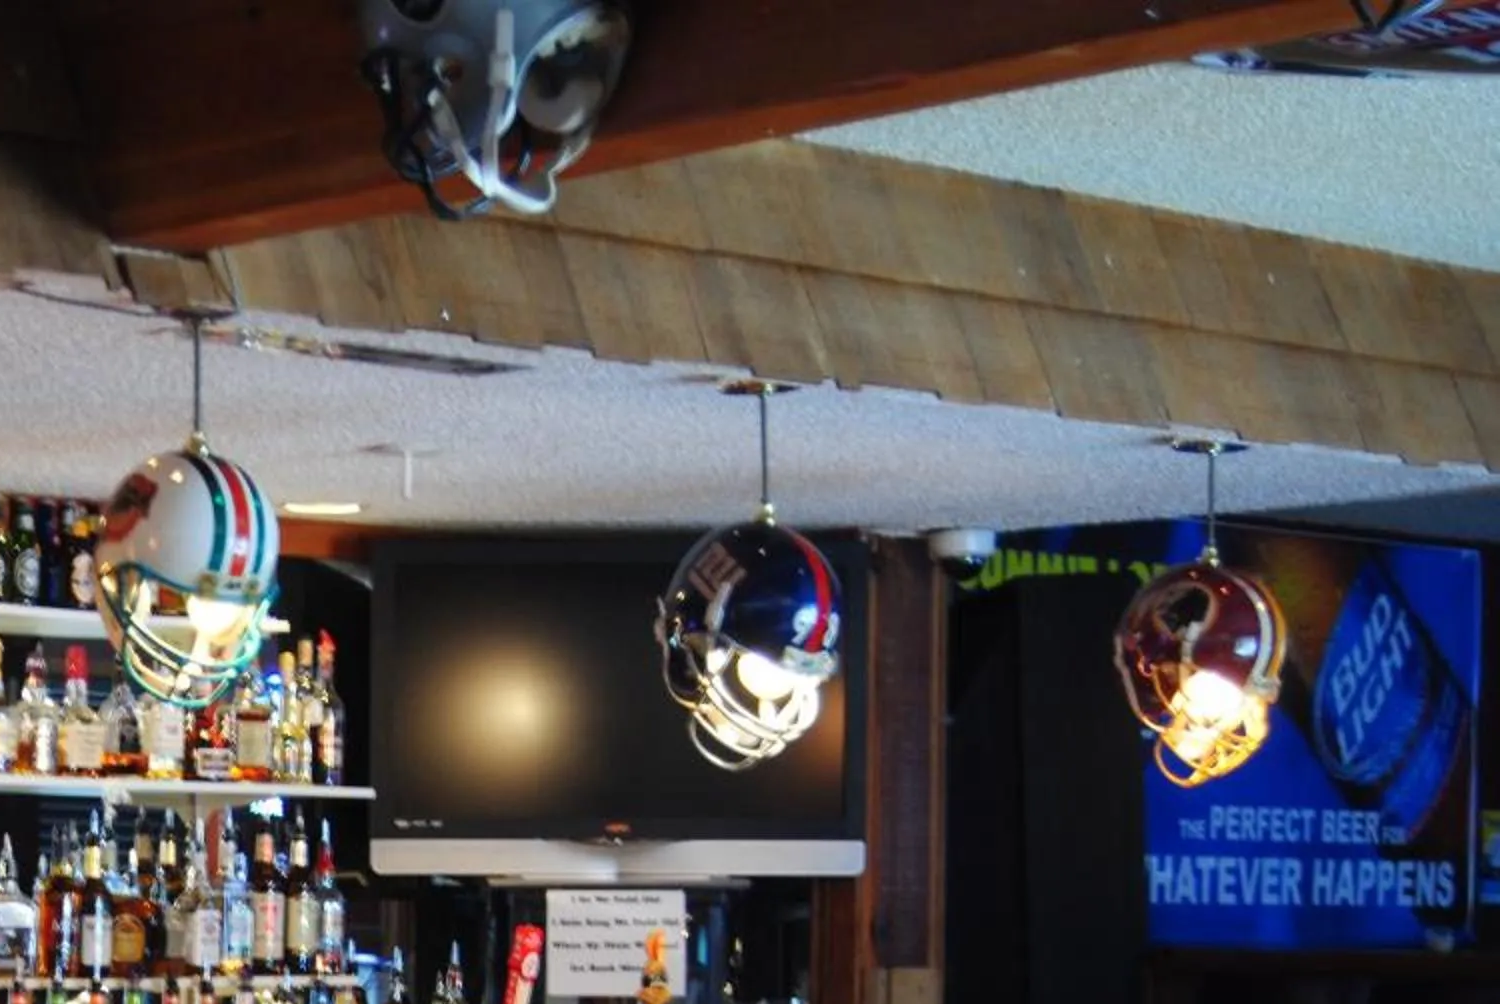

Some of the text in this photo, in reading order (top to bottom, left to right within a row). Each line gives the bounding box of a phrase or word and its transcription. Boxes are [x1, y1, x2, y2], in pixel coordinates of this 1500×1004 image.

[1332, 594, 1392, 716] BUD
[1336, 609, 1412, 765] LIGHT
[1178, 818, 1206, 840] THE
[1209, 804, 1316, 842] PERFECT
[1321, 809, 1380, 844] BEER
[1145, 854, 1455, 908] HATEVER HAPPENS
